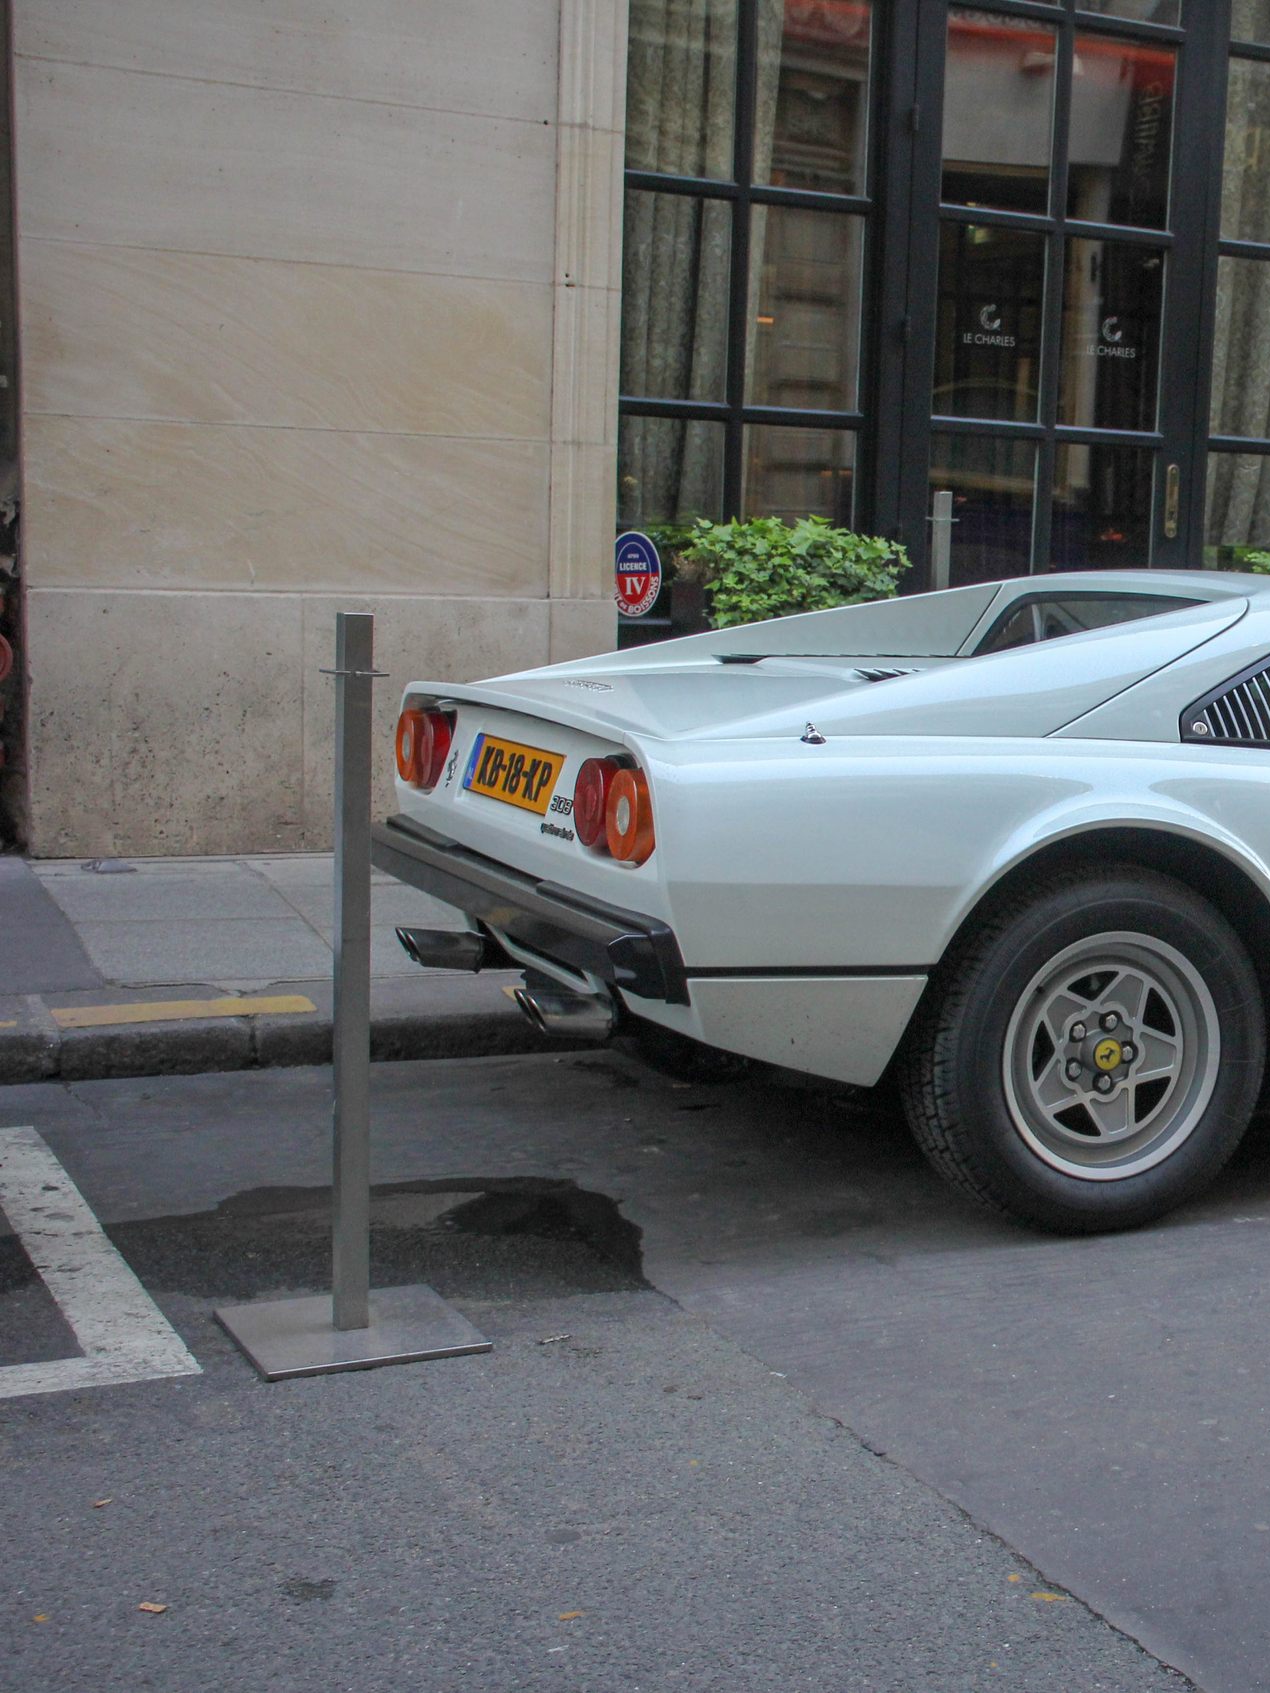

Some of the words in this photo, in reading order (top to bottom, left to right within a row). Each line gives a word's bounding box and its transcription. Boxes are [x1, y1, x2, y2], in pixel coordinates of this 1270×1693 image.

[963, 333, 972, 344] LE
[975, 334, 1016, 347] CHARLES
[1086, 345, 1095, 355] LE
[1097, 345, 1136, 358] CHARLES
[620, 562, 647, 571] LICENCE
[624, 577, 646, 595] IV
[628, 576, 659, 613] BOISSONS
[477, 745, 553, 803] KB-18-KP
[550, 795, 574, 815] 308
